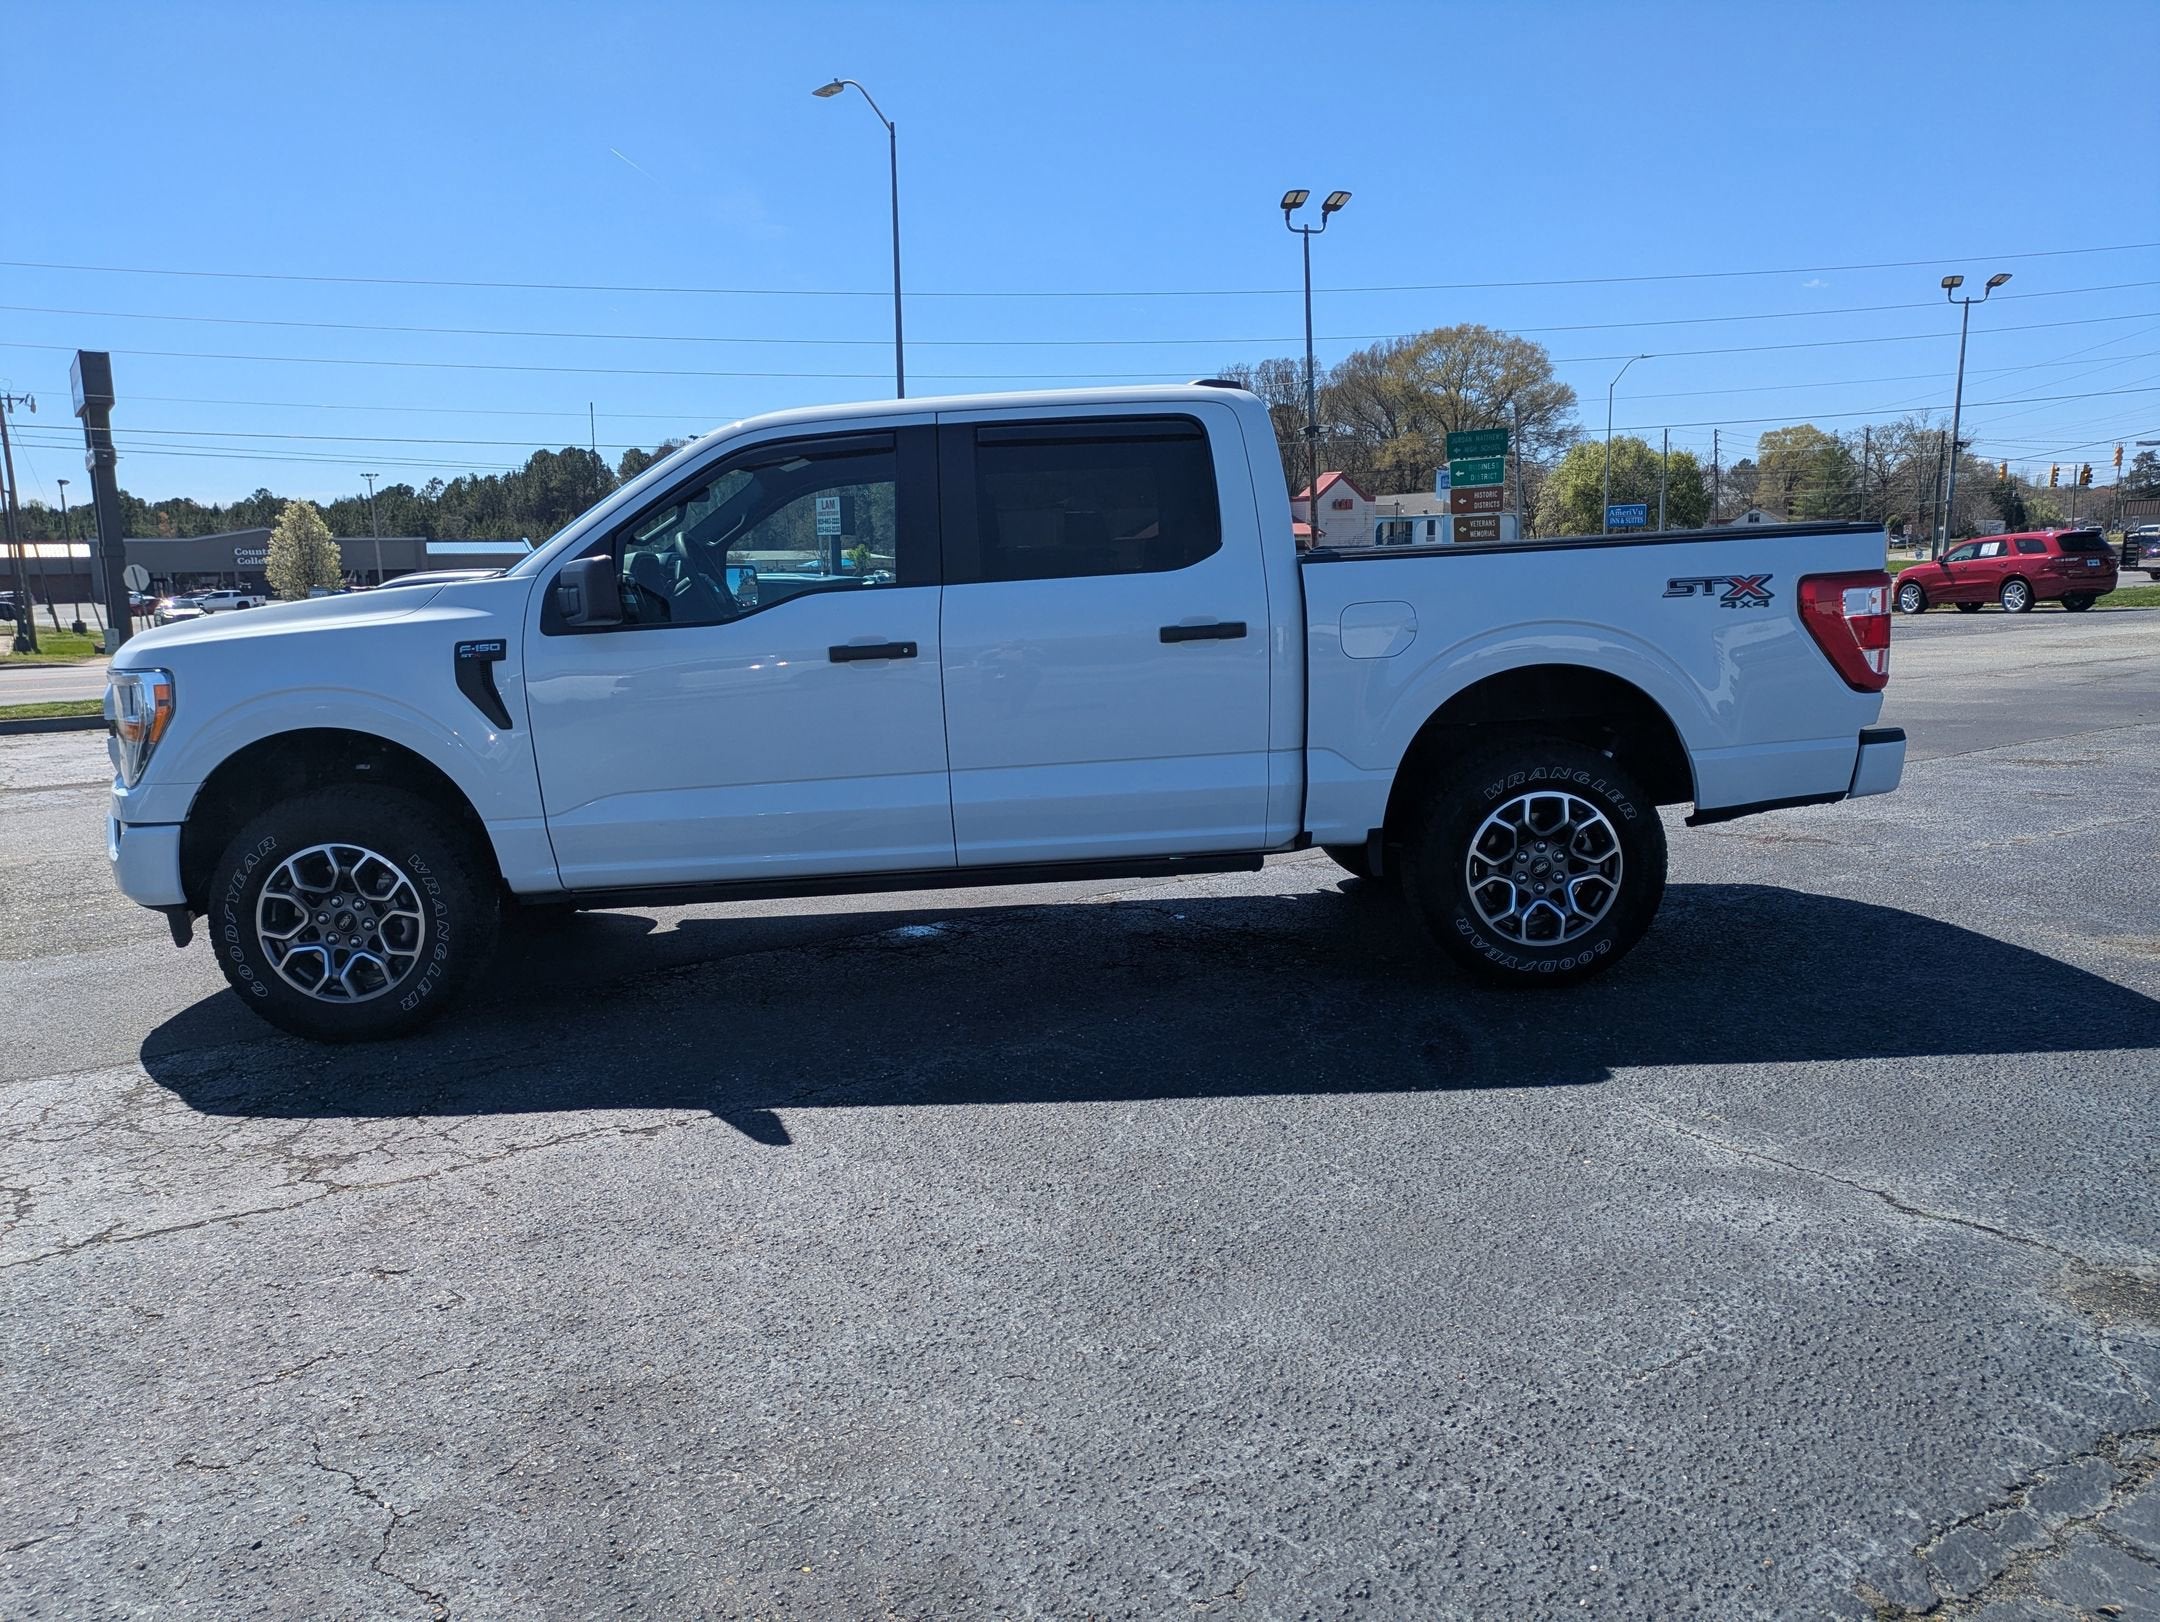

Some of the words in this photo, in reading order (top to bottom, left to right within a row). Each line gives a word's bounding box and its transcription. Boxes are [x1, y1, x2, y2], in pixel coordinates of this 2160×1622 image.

[1473, 490, 1498, 499] HISTORIC
[1473, 501, 1500, 509] DISTRICTS
[1609, 508, 1643, 516] AmeriVu
[1470, 519, 1496, 528] VETERANS
[1609, 517, 1620, 525] INN
[1470, 530, 1496, 538] MEMORIAL
[1662, 574, 1775, 601] STX
[459, 643, 501, 653] F-150
[1483, 766, 1638, 820] WRANGLER
[400, 854, 450, 1010] WRANGLER
